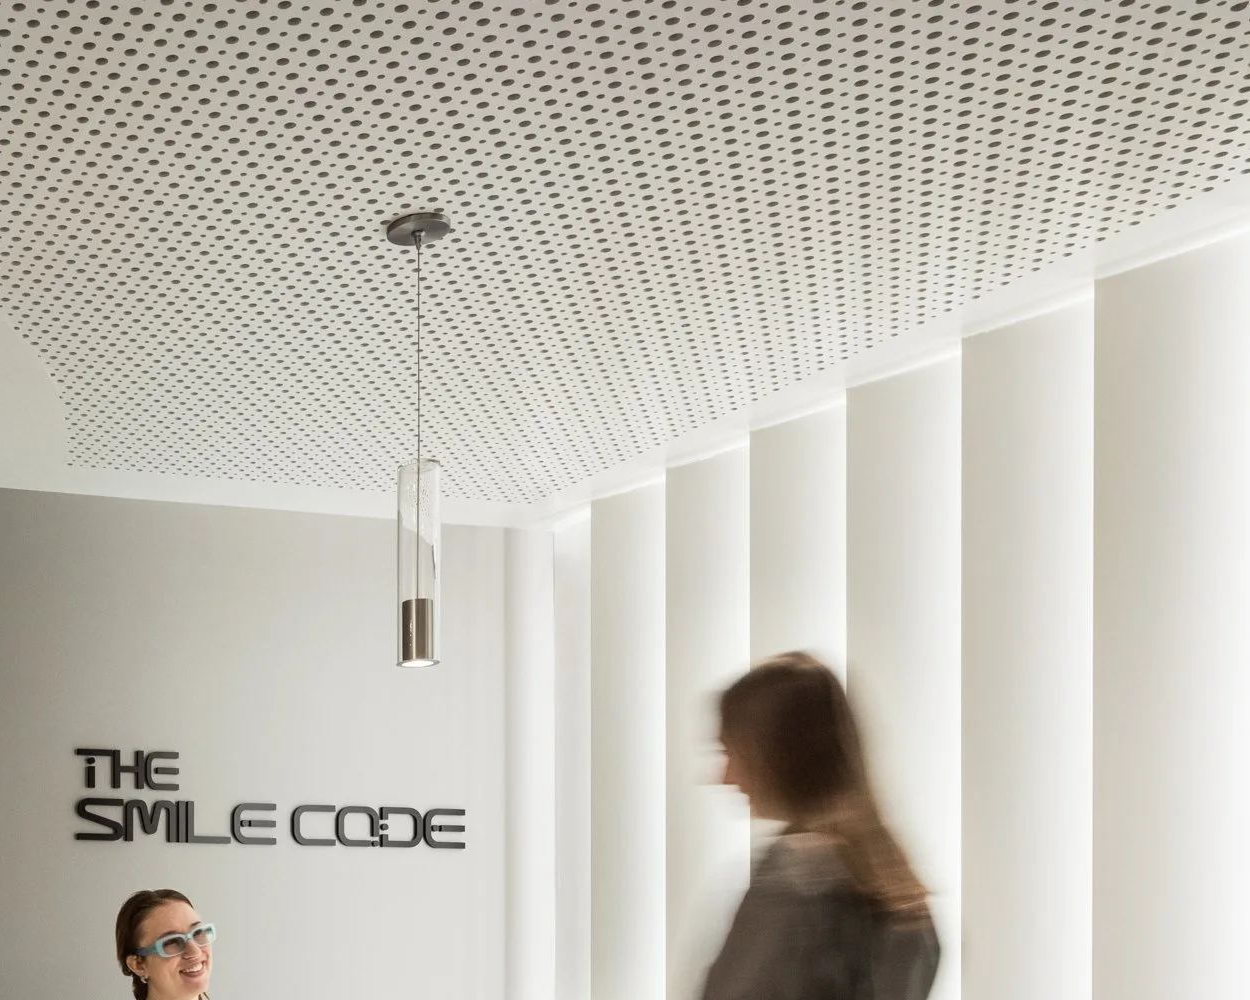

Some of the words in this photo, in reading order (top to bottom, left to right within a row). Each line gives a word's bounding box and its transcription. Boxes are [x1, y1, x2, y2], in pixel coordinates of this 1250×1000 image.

[74, 748, 180, 792] THE
[74, 797, 277, 846] SMILE
[290, 804, 466, 849] CODE
